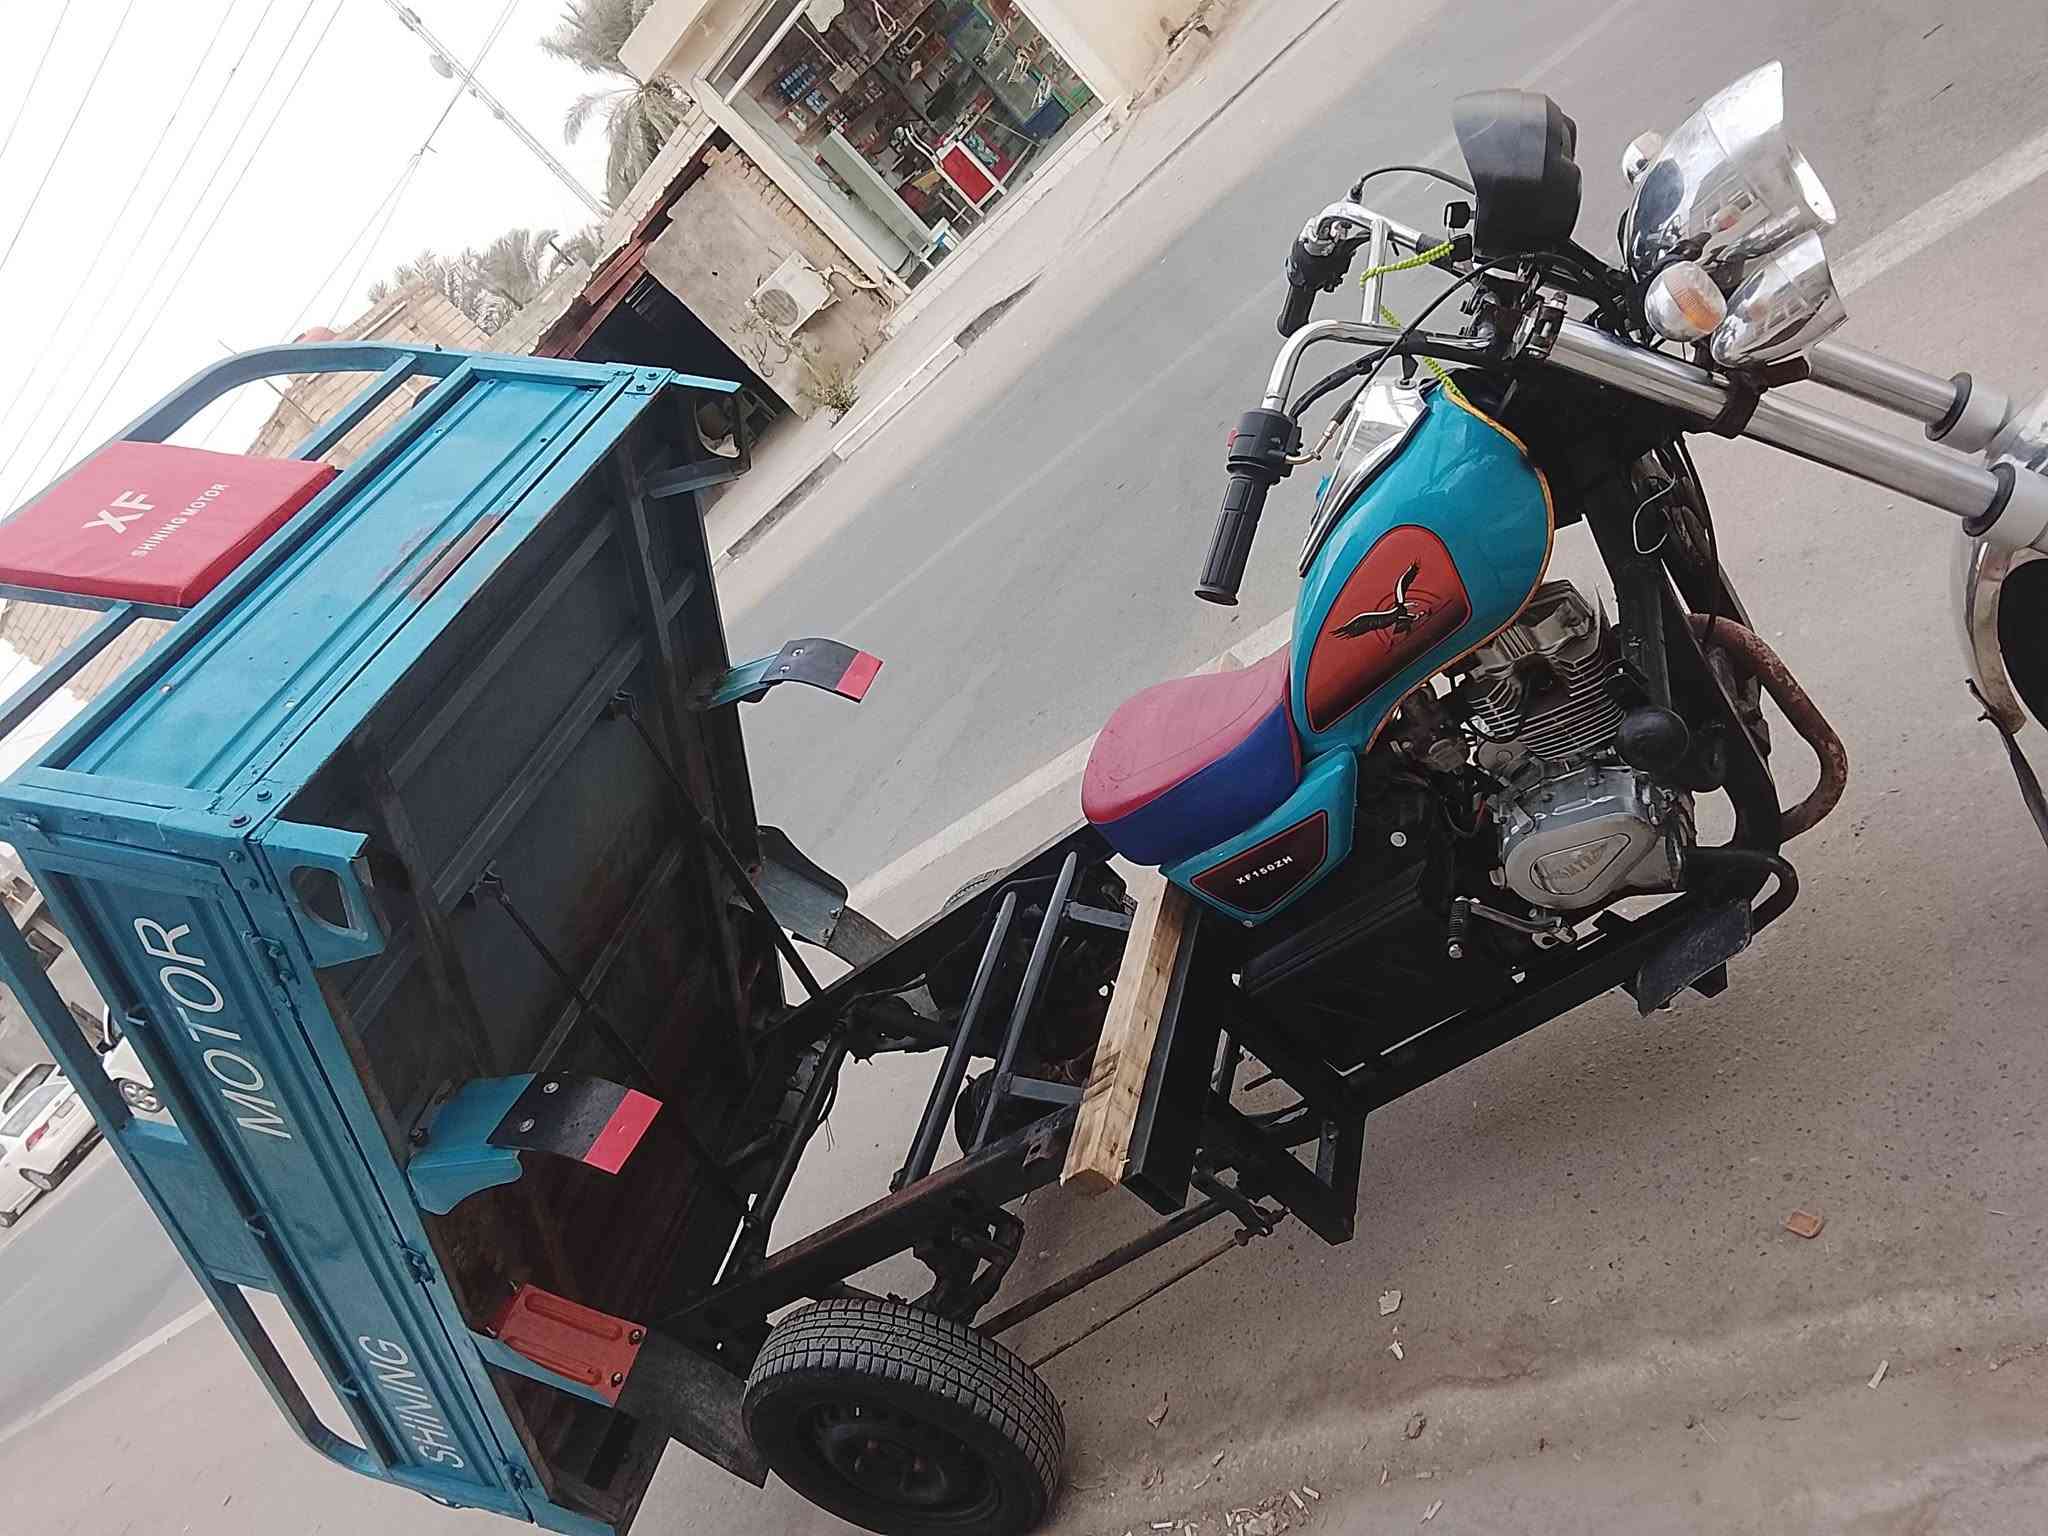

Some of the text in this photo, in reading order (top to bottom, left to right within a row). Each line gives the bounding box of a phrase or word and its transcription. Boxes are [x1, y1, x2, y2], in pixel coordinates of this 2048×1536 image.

[82, 490, 156, 535] XF
[131, 483, 230, 558] SHINING MOTOR
[1235, 855, 1293, 885] XF150ZH
[134, 916, 465, 1469] SHINING MOTOR
